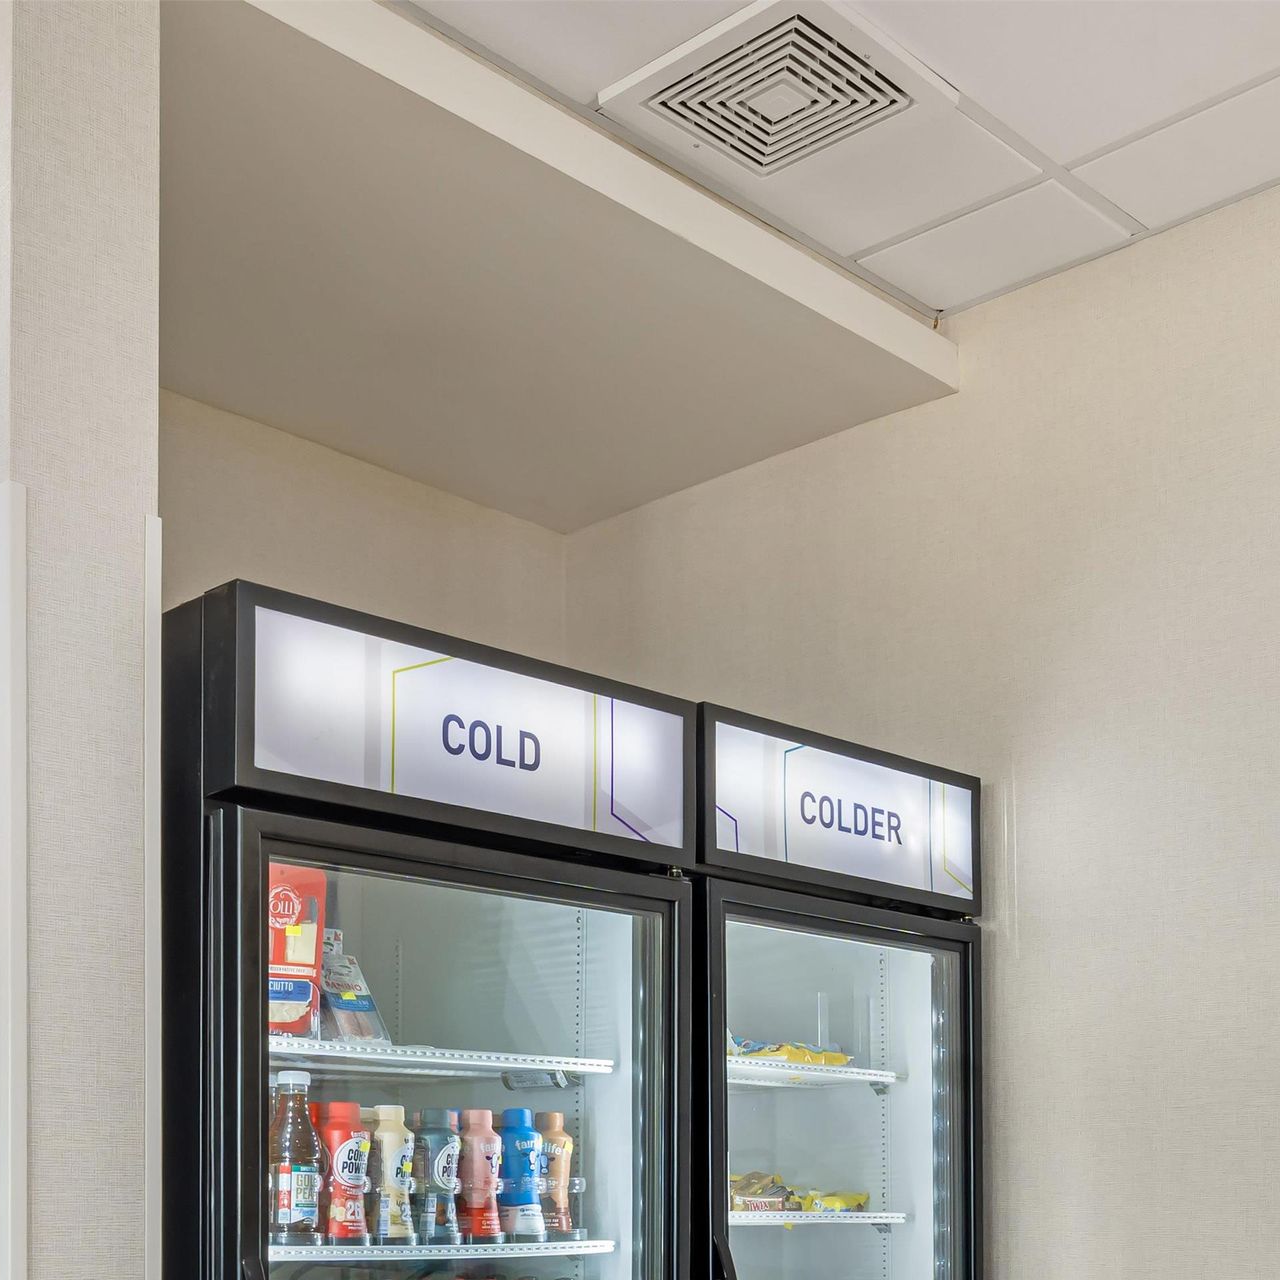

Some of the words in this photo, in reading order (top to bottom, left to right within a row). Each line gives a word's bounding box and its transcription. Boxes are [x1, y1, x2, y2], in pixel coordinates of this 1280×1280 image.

[442, 714, 540, 771] COLD
[800, 791, 903, 846] COLDER
[270, 900, 293, 914] OLLI
[269, 980, 294, 991] CIUTTO
